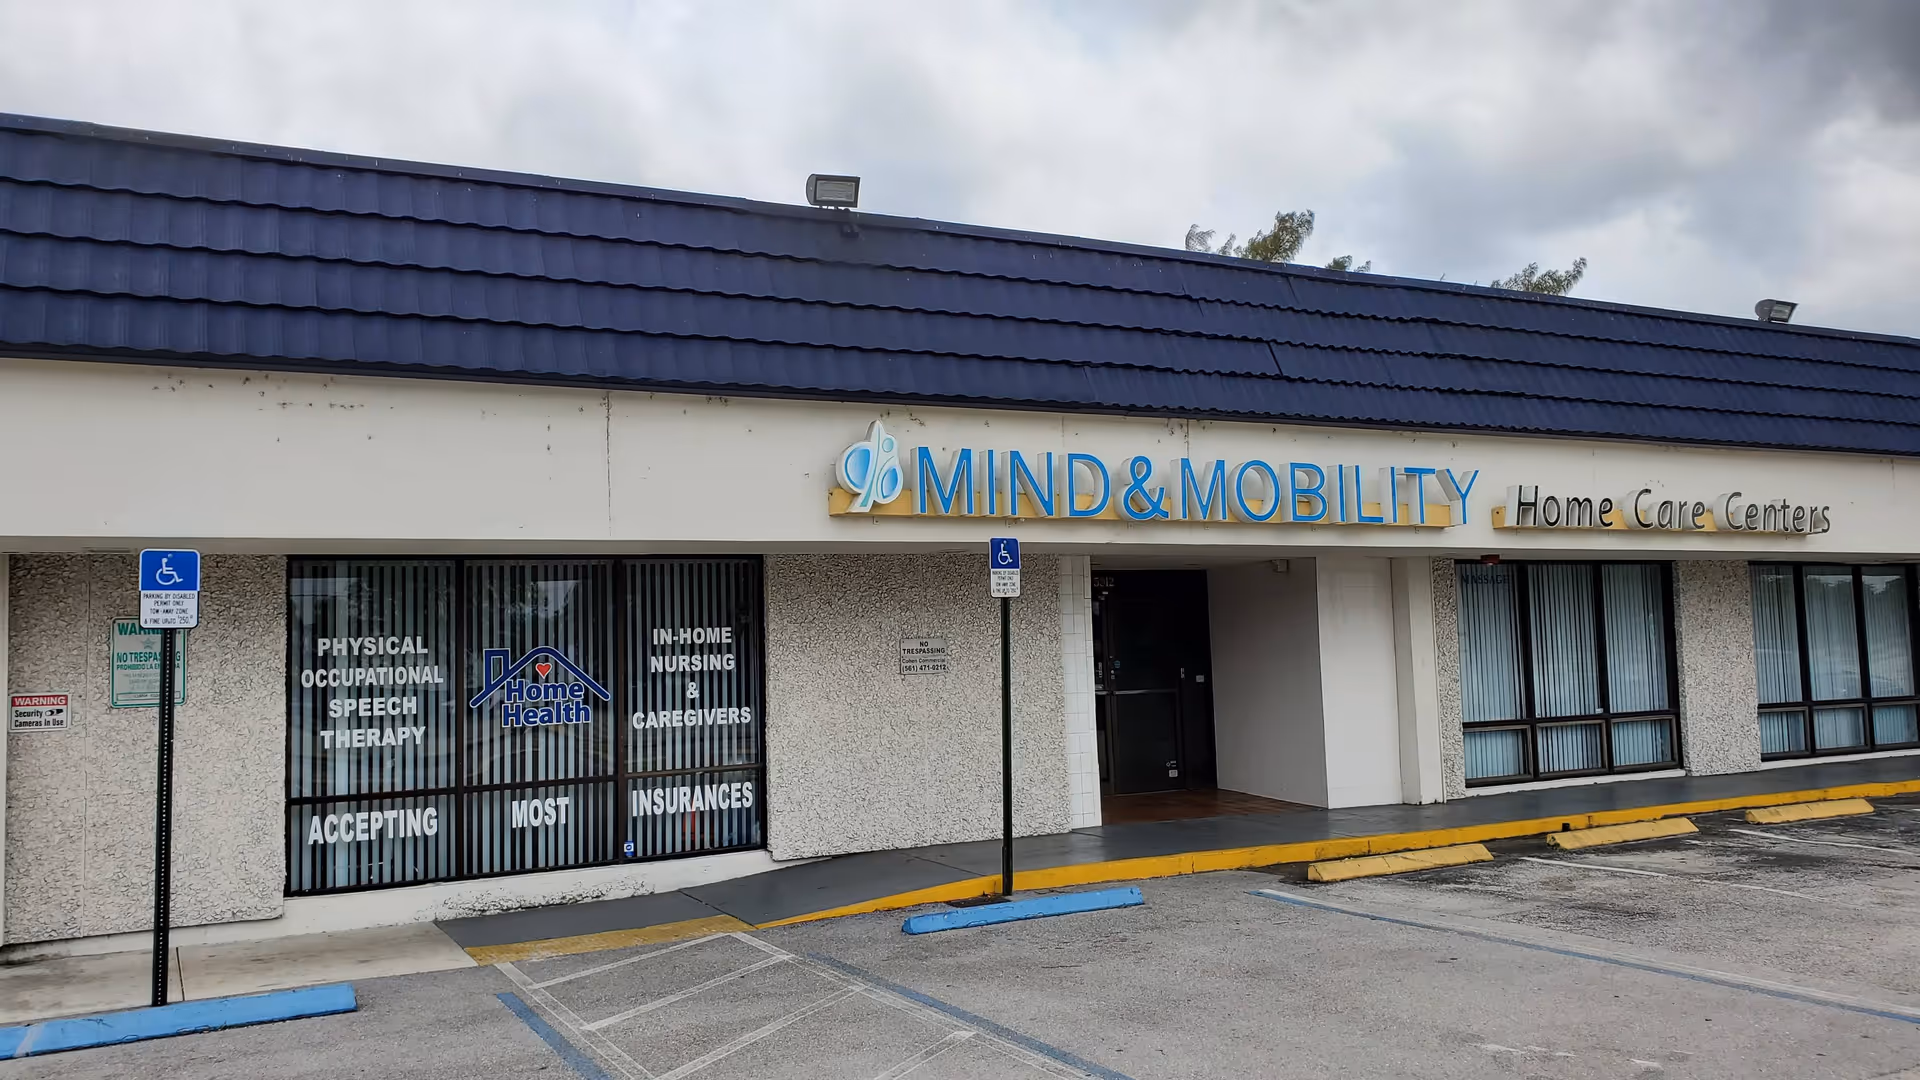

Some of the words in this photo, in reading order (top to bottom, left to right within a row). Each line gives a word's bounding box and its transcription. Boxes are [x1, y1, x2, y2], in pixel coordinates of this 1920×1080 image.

[1515, 484, 1614, 528] Home
[1633, 488, 1706, 530] Care
[1724, 491, 1832, 534] Centers
[317, 636, 429, 657] PHYSICAL
[653, 627, 733, 645] IN-HOME
[116, 652, 128, 663] NO
[902, 647, 946, 655] TRESPASSING
[650, 654, 736, 673] NURSING
[301, 665, 444, 688] OCCUPATIONAL
[505, 679, 585, 703] Home
[686, 681, 700, 699] &
[14, 696, 66, 706] WARNING
[328, 696, 417, 718] SPEECH
[14, 709, 43, 718] Security
[14, 719, 43, 727] Cameras
[52, 718, 64, 726] Use
[501, 700, 592, 728] Health
[632, 706, 752, 729] CAREGIVERS
[320, 726, 426, 750] THERAPY
[307, 806, 439, 845] ACCEPTING
[511, 797, 570, 829] MOST
[632, 781, 754, 817] INSURANCES
